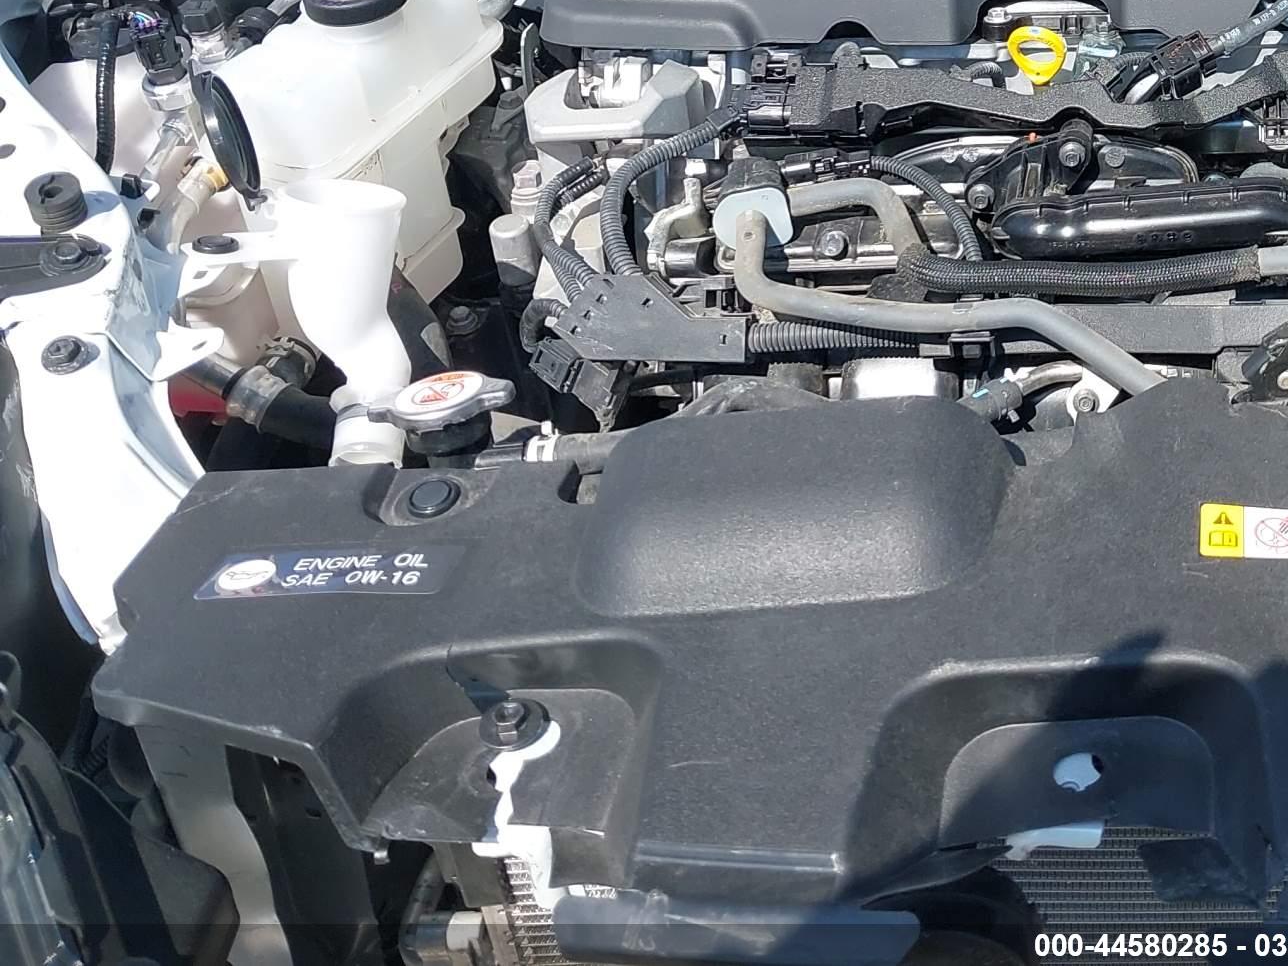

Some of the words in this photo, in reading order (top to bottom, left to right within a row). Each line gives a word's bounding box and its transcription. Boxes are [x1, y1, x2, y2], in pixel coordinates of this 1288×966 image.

[293, 555, 382, 571] ENGINE
[393, 553, 428, 568] OIL
[281, 572, 333, 587] SAE
